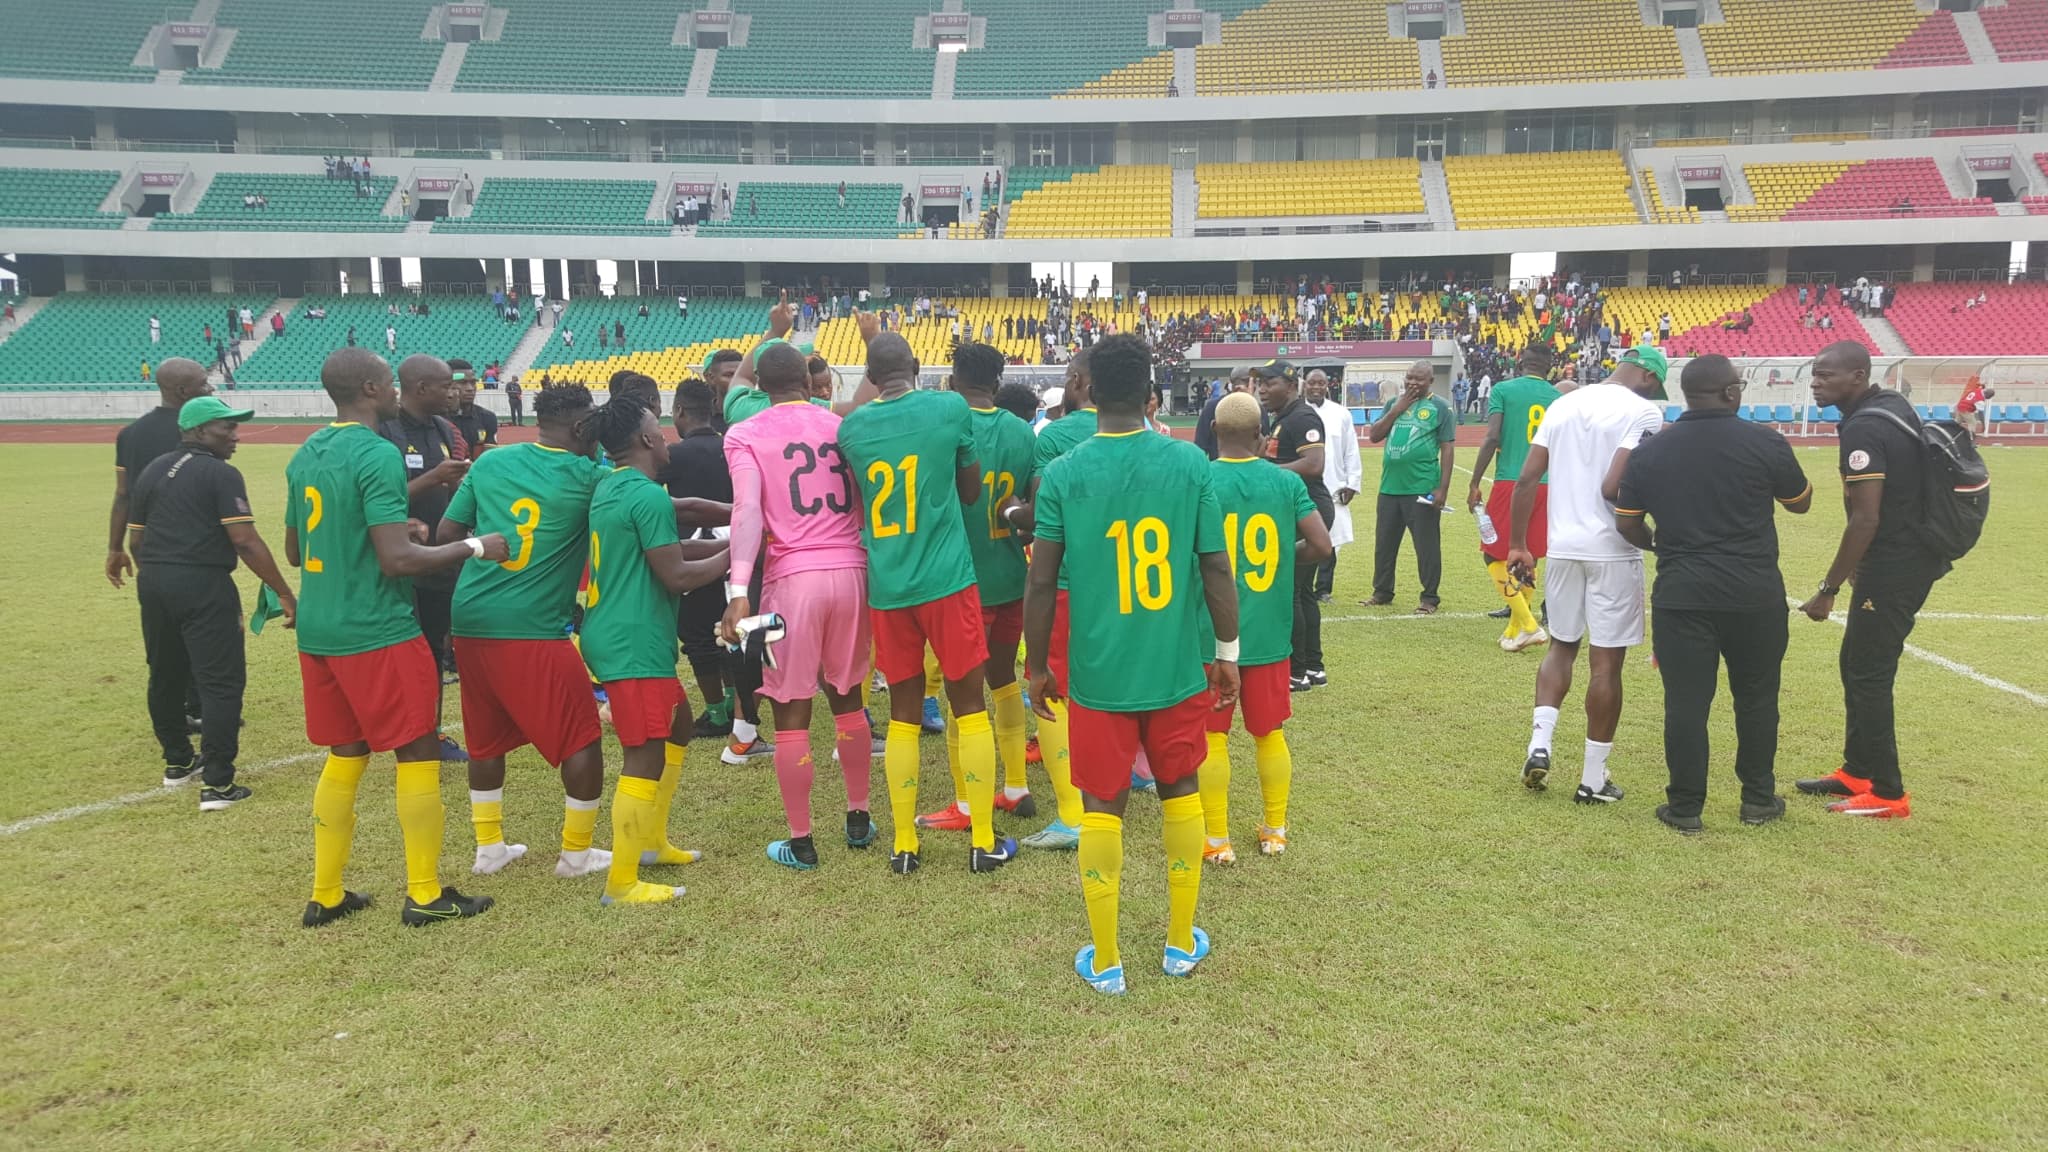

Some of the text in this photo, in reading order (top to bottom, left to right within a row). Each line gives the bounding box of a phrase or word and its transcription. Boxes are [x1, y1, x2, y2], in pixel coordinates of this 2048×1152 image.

[1527, 404, 1545, 444] 8
[783, 442, 852, 516] 23
[867, 454, 918, 538] 21
[982, 470, 1015, 539] 12
[304, 486, 323, 573] 2
[501, 497, 541, 572] 3
[1105, 516, 1173, 614] 18
[1223, 513, 1280, 592] 19
